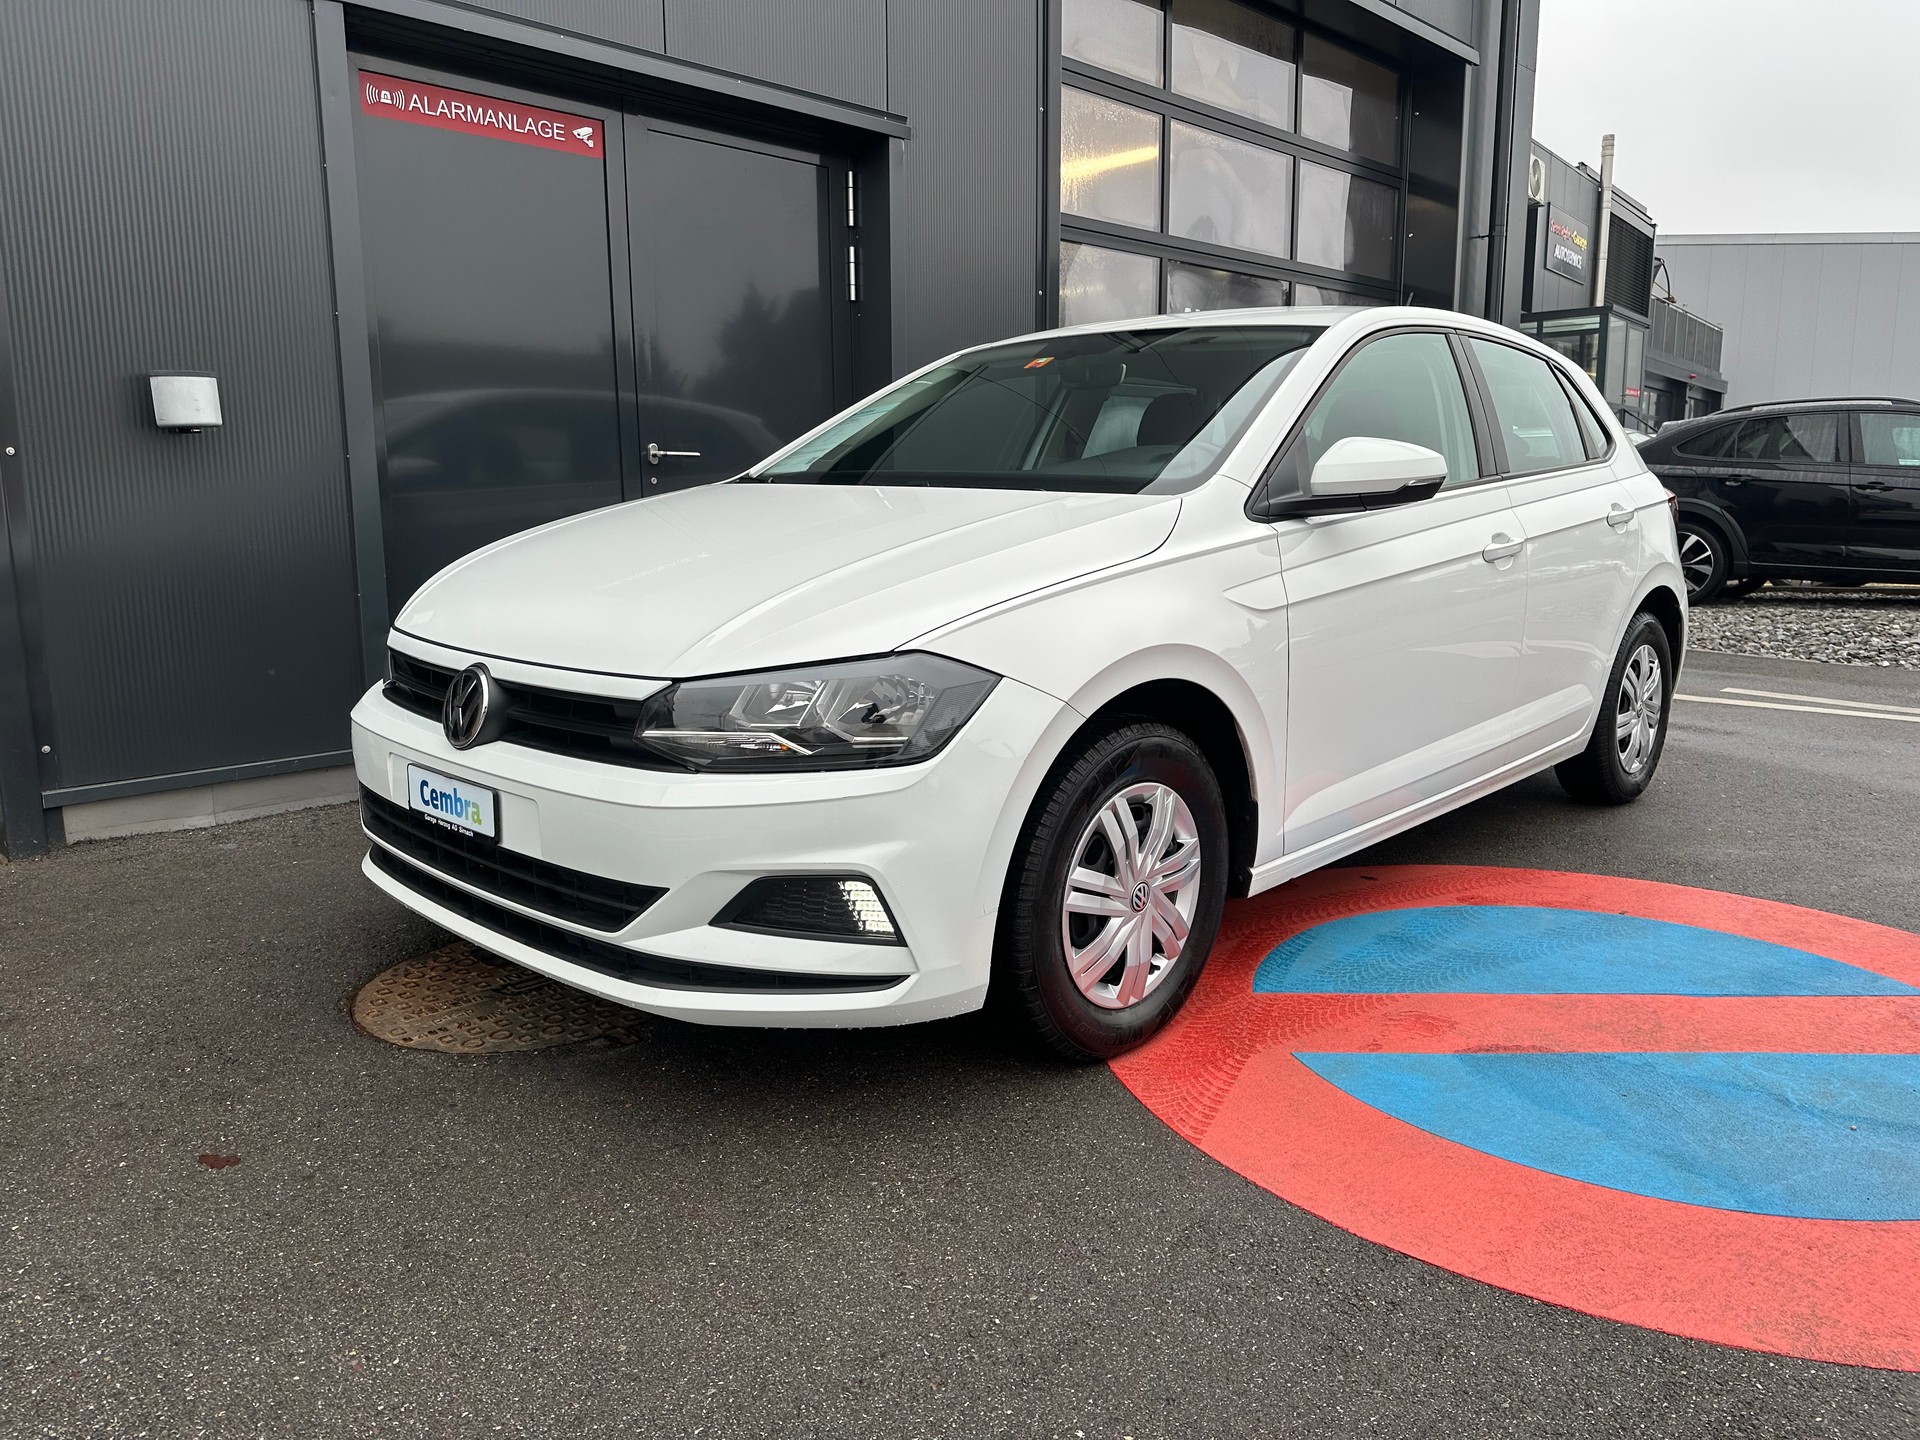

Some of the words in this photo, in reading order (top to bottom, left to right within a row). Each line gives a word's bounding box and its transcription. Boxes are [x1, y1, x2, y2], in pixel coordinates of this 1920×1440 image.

[408, 94, 566, 141] ALARMANLAGE
[420, 779, 482, 826] Cembra
[424, 813, 437, 825] Garage
